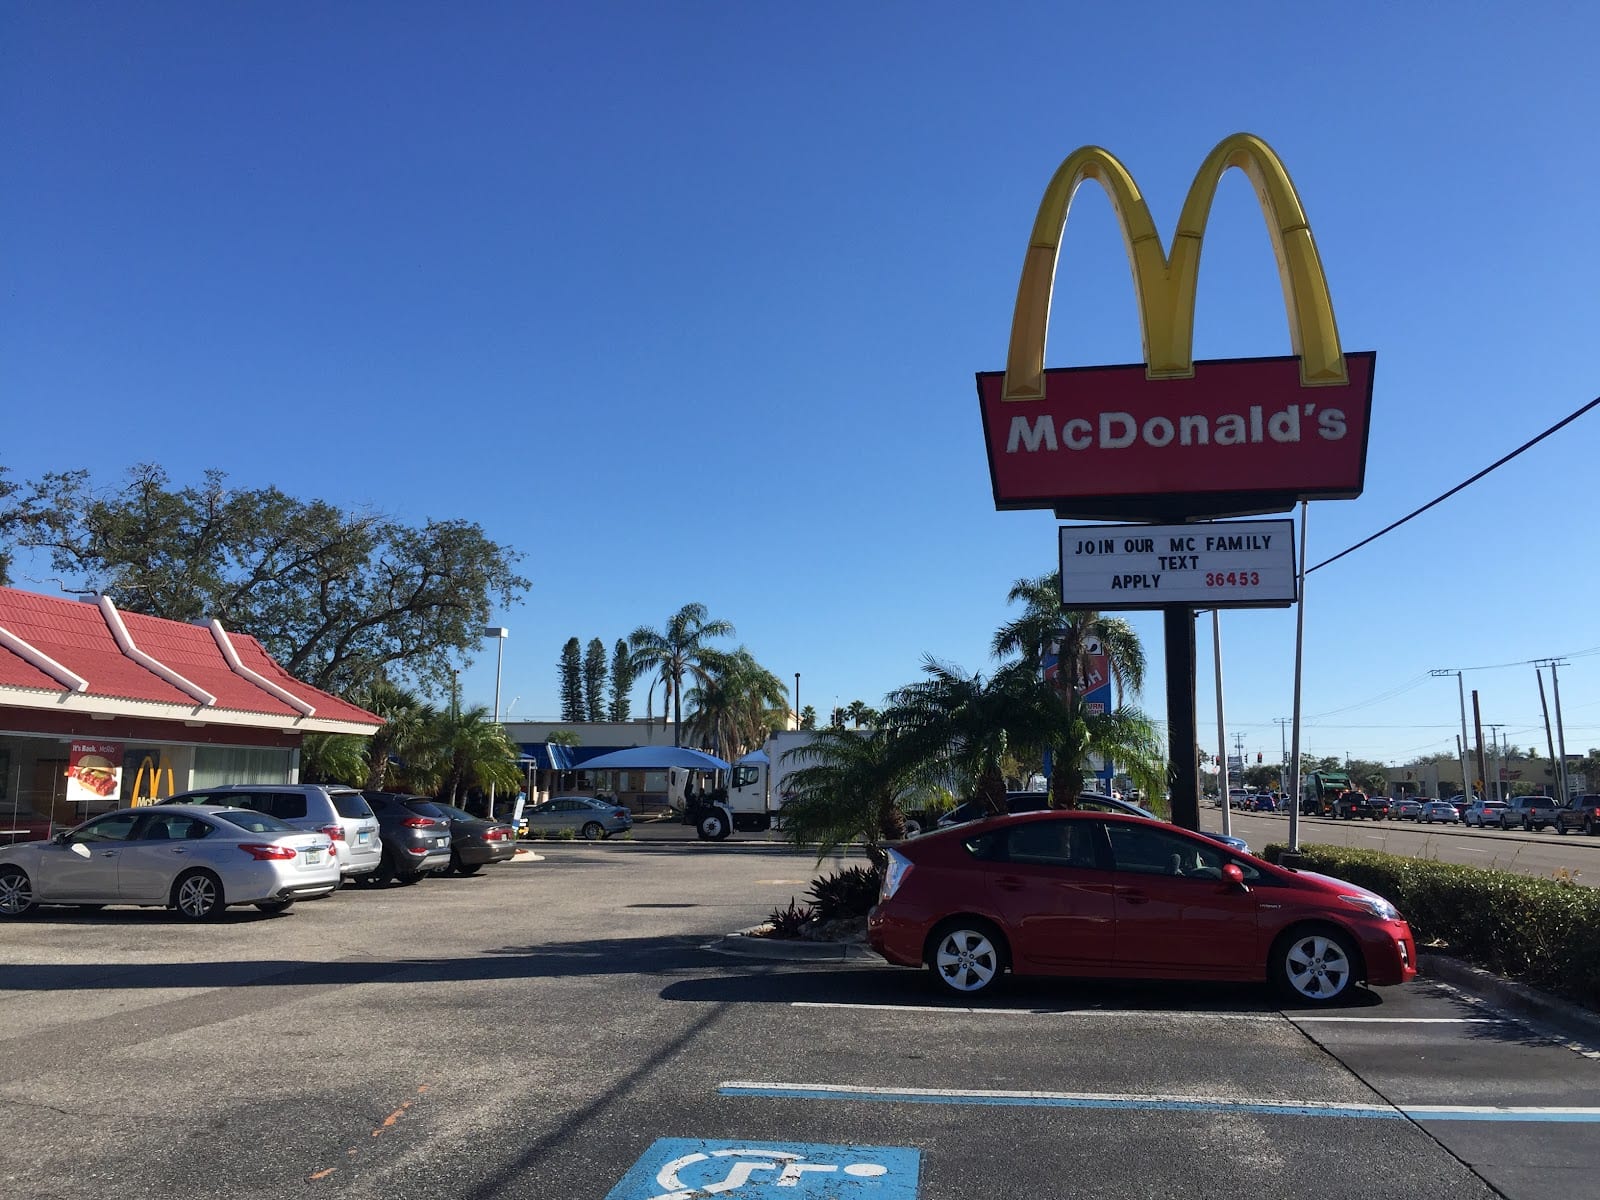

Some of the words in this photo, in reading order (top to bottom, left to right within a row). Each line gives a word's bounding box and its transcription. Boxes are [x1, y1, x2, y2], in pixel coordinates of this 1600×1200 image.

[1006, 403, 1348, 453] McDonald's
[1075, 538, 1114, 555] JOIN
[1124, 537, 1154, 553] OUR
[1170, 537, 1196, 552] MC
[1206, 535, 1272, 551] FAMILY
[1158, 555, 1199, 570] TEXT
[1112, 574, 1161, 589] APPLY
[1205, 571, 1260, 587] 36453
